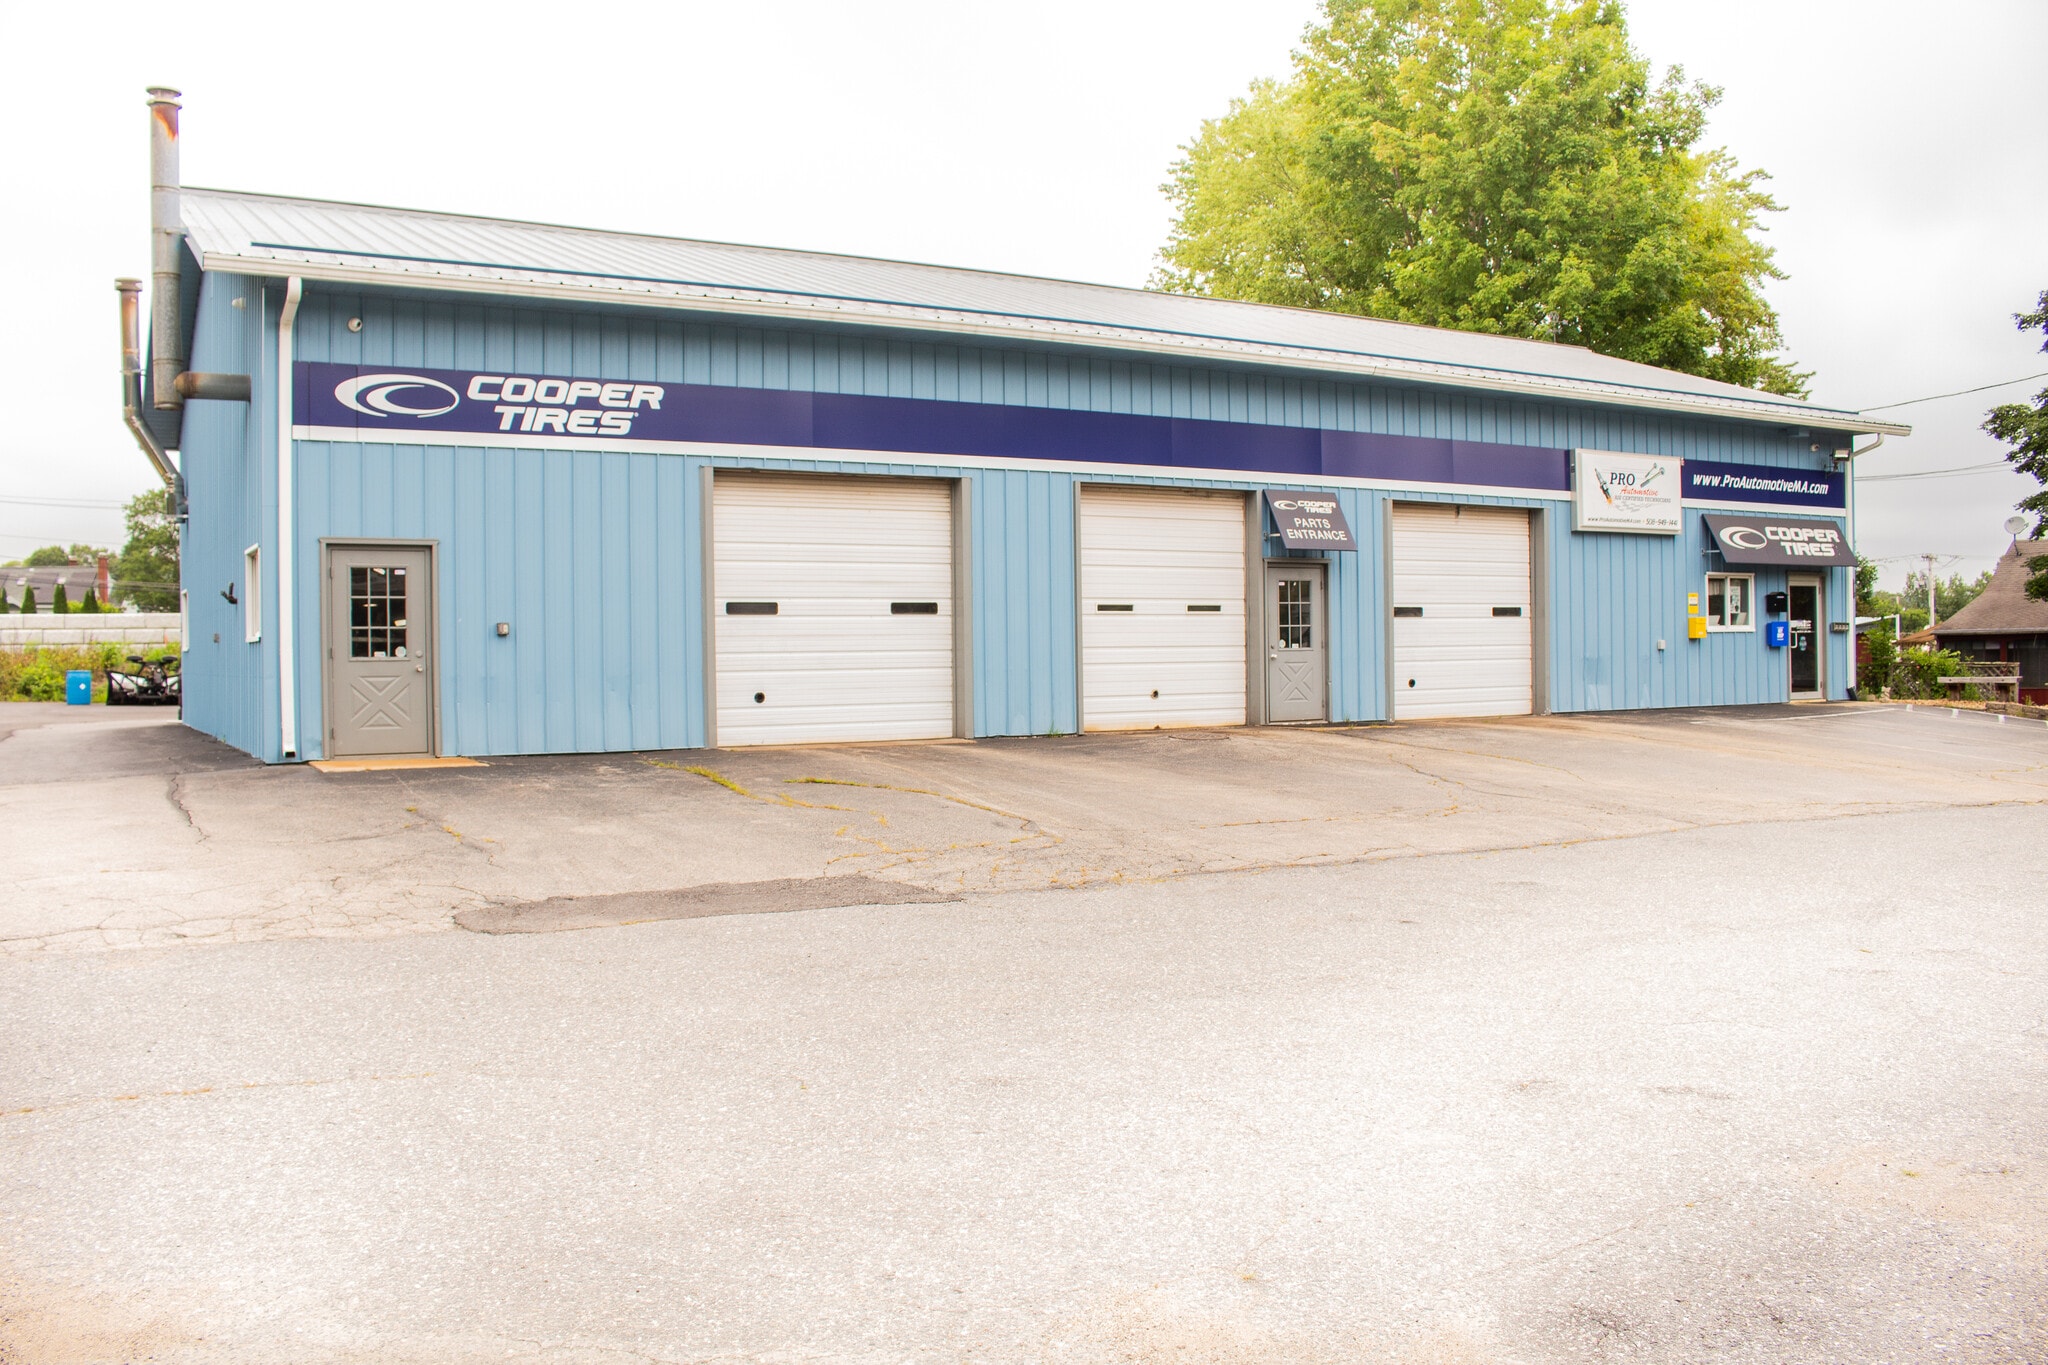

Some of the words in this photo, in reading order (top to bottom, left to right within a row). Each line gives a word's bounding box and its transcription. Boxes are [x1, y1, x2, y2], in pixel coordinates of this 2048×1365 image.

[466, 374, 665, 411] COOPER
[494, 404, 634, 435] TIRES
[1609, 472, 1636, 486] PRO
[1692, 474, 1829, 495] www.ProAutomotiveMA.com
[1620, 486, 1658, 496] Automotive
[1297, 500, 1337, 509] COOPER
[1304, 506, 1333, 514] TIRES
[1293, 517, 1331, 529] PARTS
[1286, 528, 1348, 541] ENTRANCE
[1764, 526, 1840, 543] COOPER
[1780, 541, 1836, 557] TIRES
